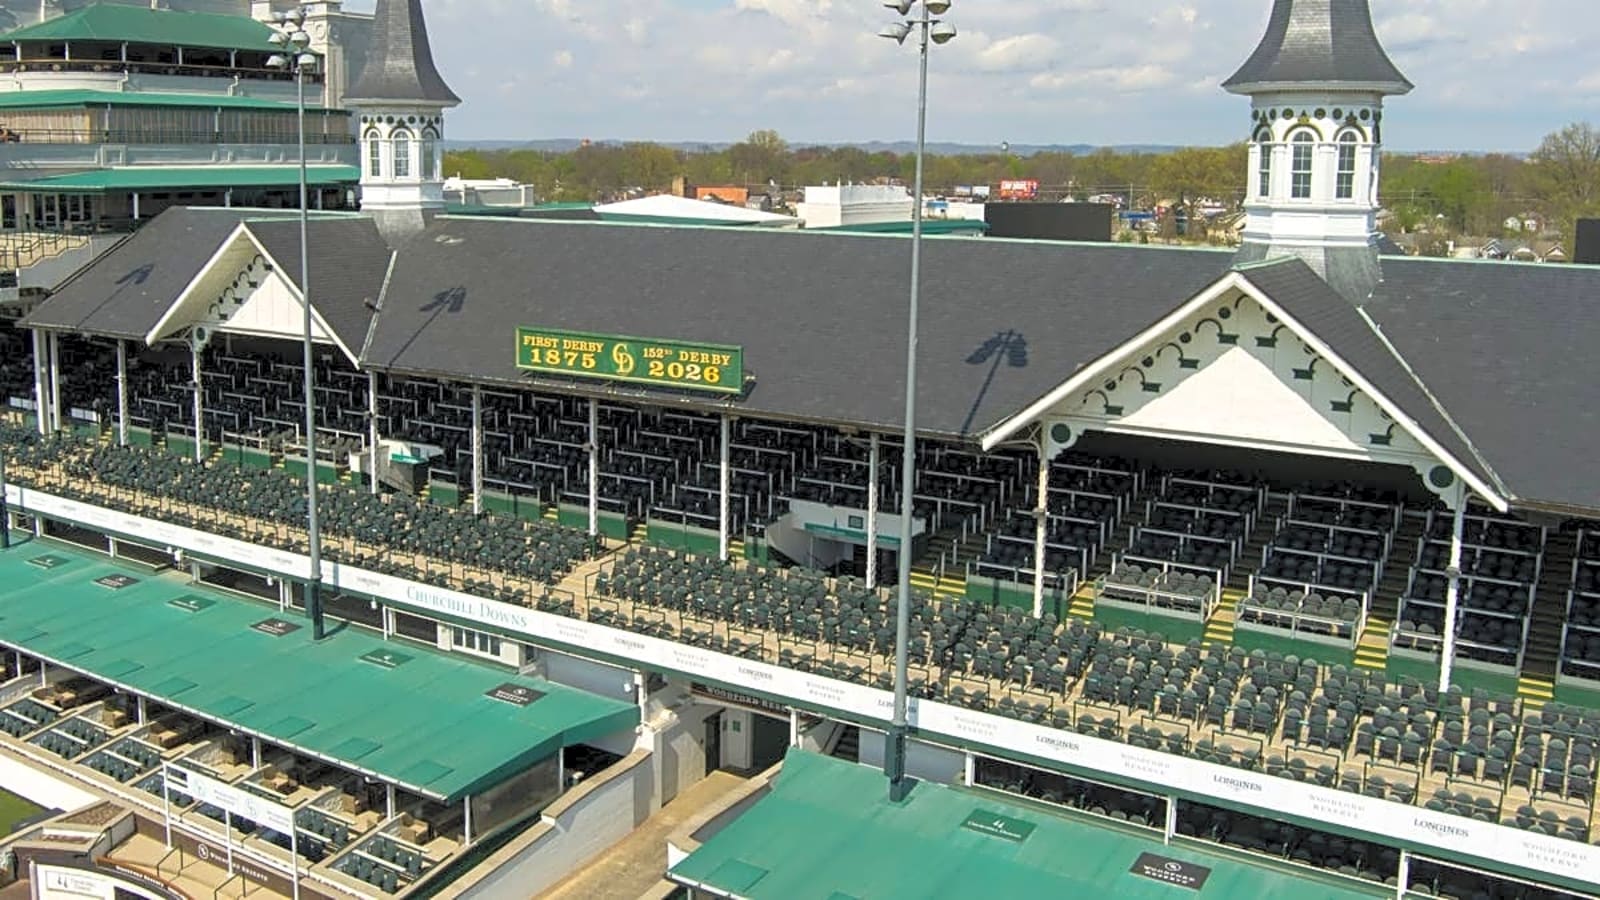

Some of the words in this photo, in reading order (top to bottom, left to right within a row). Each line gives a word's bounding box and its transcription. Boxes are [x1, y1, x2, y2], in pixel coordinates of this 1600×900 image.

[523, 335, 559, 349] FIRST
[563, 339, 605, 354] DERBY
[530, 349, 597, 369] 1875
[679, 351, 731, 366] DERBY
[649, 360, 720, 383] 2026
[480, 602, 527, 627] DOWNS
[1036, 734, 1080, 752] LONGINES
[1213, 773, 1263, 792] LONGINES
[1413, 818, 1469, 838] LONGINES
